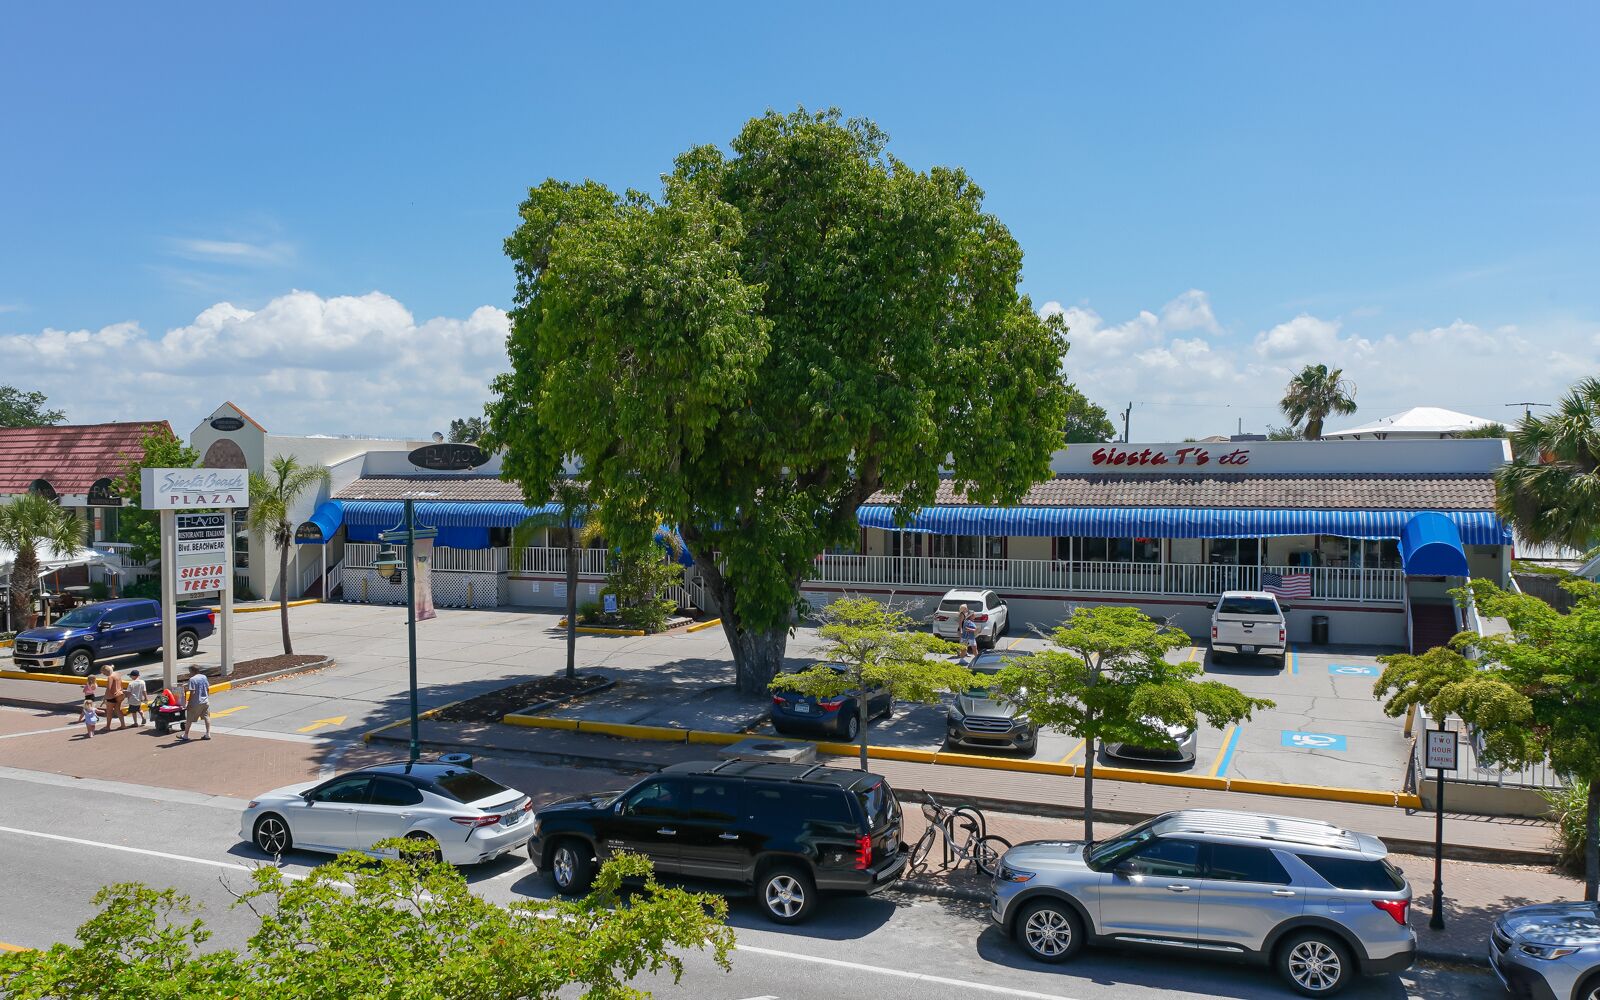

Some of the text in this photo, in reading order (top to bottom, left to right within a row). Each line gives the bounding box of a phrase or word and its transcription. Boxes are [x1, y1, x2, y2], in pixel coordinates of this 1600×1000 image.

[1092, 447, 1249, 466] Siesta T's etc
[159, 472, 244, 493] Siesta Beach
[170, 494, 236, 505] PLAZA
[192, 541, 225, 551] BEACHWEAR
[181, 565, 223, 578] SIESTA
[184, 578, 220, 591] TEE'S
[1431, 746, 1452, 754] HOUR
